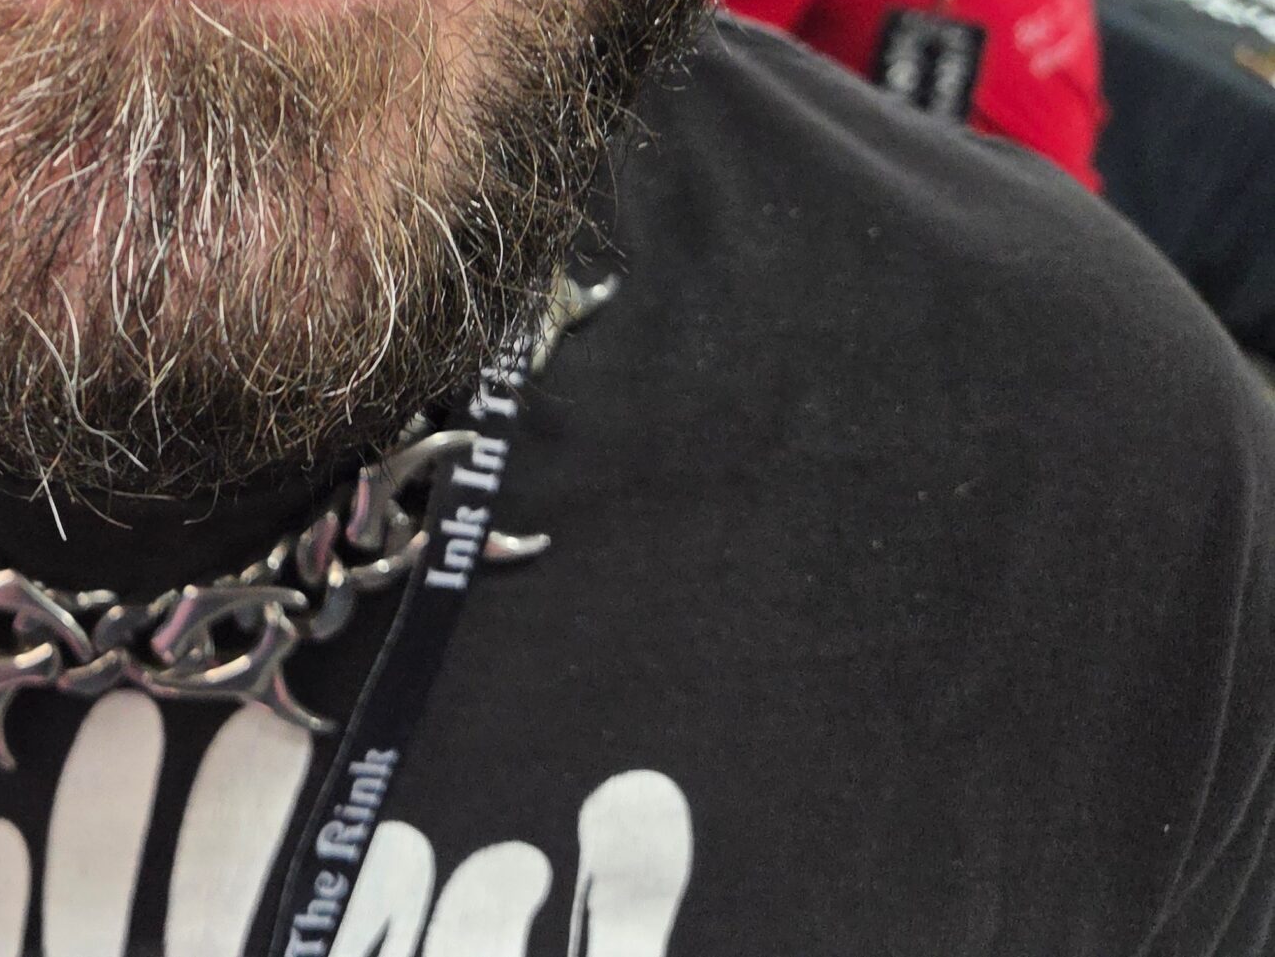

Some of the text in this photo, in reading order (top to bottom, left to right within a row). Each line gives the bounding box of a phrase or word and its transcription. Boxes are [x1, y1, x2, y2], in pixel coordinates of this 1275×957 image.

[452, 435, 509, 492] In
[425, 505, 491, 590] Ink
[284, 748, 400, 957] The Rink
